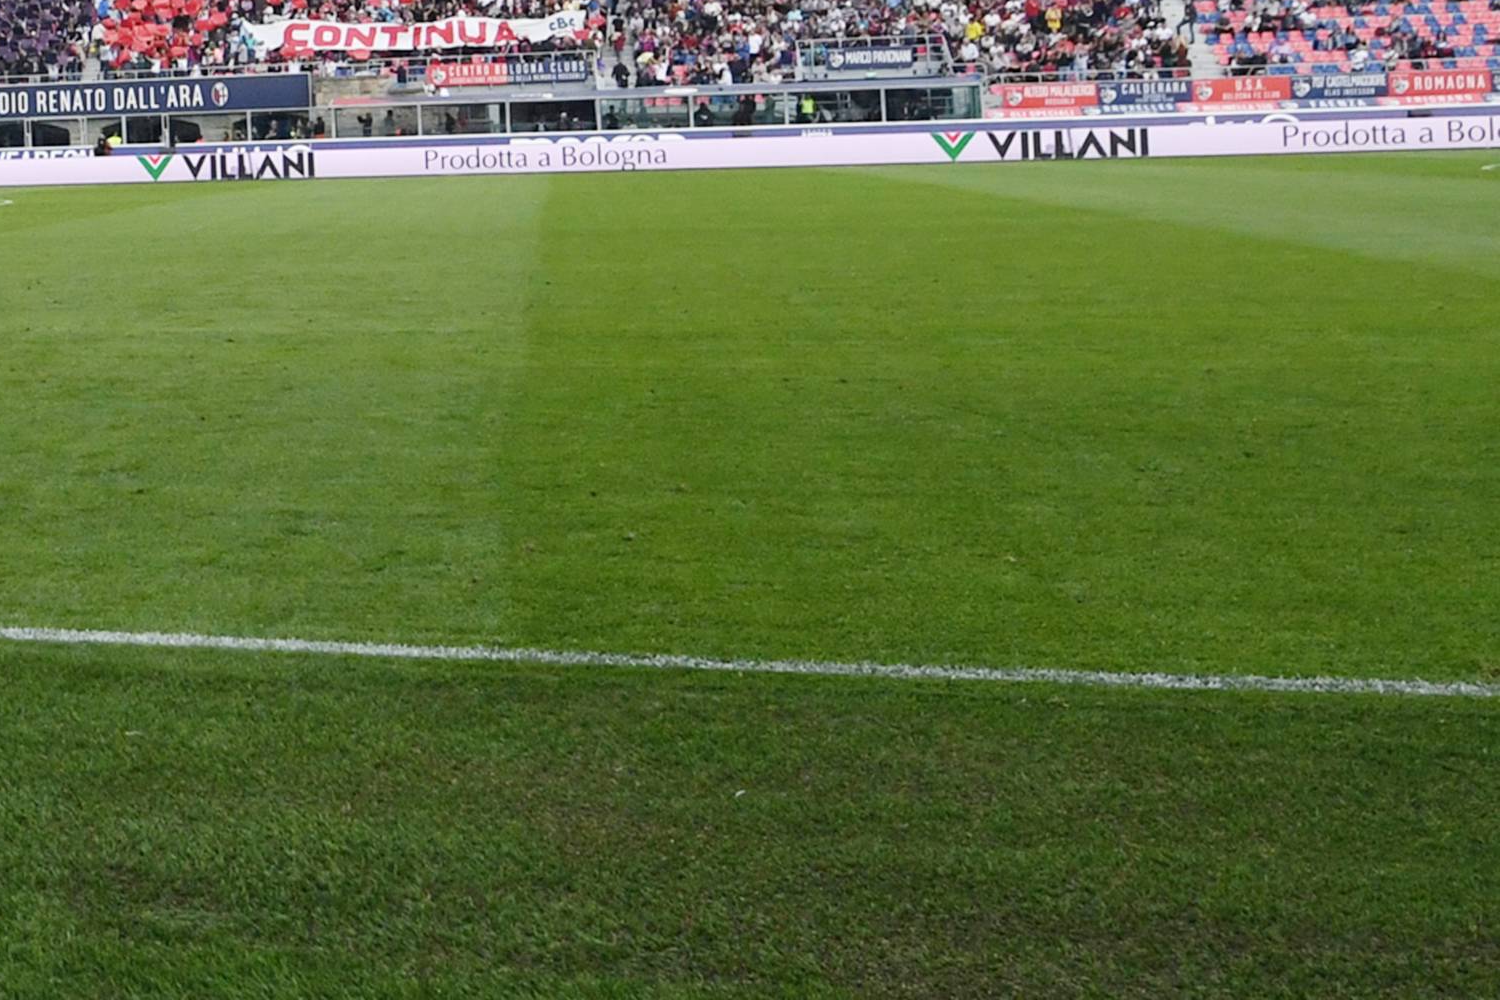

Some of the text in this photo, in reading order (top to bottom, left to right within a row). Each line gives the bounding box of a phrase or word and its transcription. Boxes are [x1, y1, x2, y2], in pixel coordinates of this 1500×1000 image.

[283, 20, 518, 50] CONTINUA
[449, 60, 585, 77] CENTRO BOLOGNA CLUBS
[1414, 74, 1486, 91] ROMAGNA
[36, 88, 106, 113] RENATO
[113, 83, 204, 111] DALL'ARA
[1120, 80, 1188, 95] CALDERARA
[987, 128, 1149, 160] VILLANI
[1283, 119, 1406, 147] Prodotta
[1419, 127, 1433, 143] a
[1447, 116, 1500, 143] Bol
[183, 152, 315, 181] VILLANI
[424, 143, 668, 172] Prodotta a Bologna
